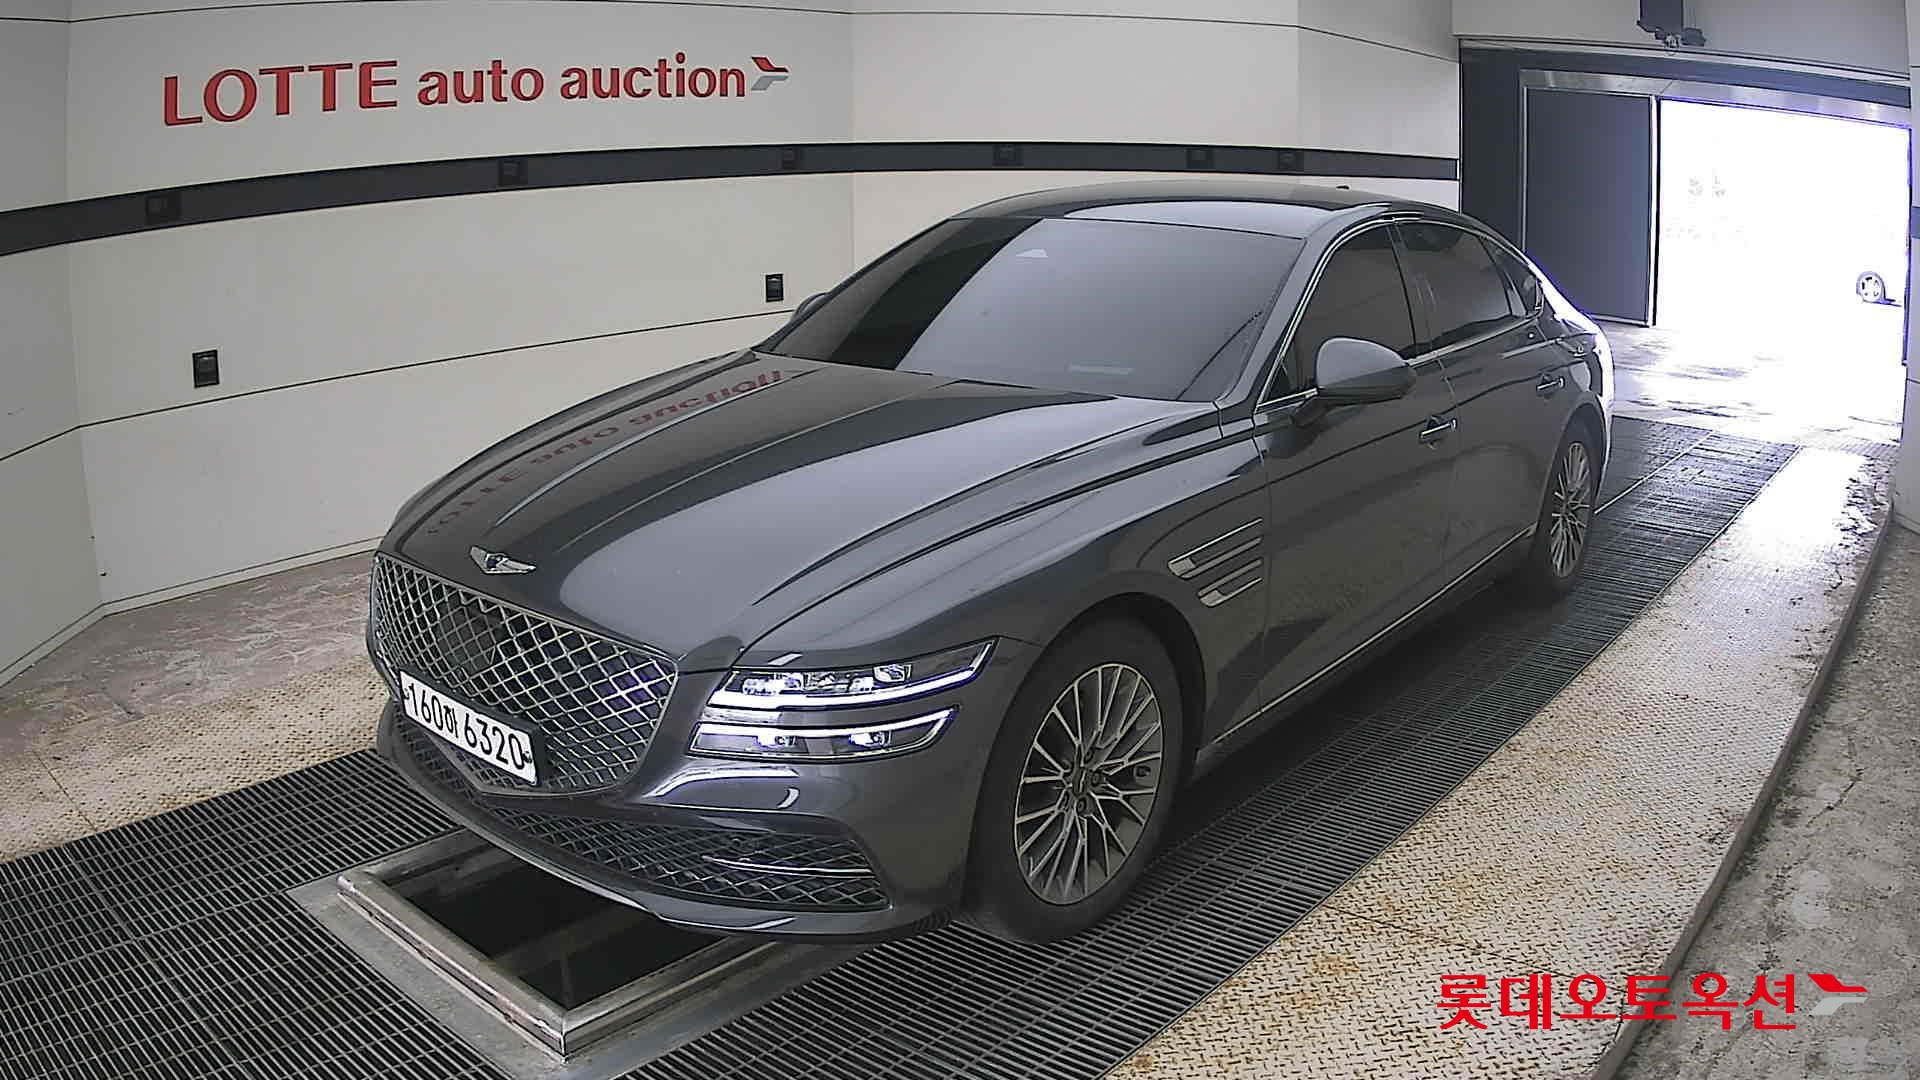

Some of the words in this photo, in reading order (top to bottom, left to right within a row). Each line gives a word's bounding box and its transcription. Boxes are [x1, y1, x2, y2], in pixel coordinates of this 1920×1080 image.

[163, 61, 398, 126] LOTTE
[417, 58, 545, 105] auto
[560, 52, 747, 98] auction
[464, 713, 525, 770] 6320
